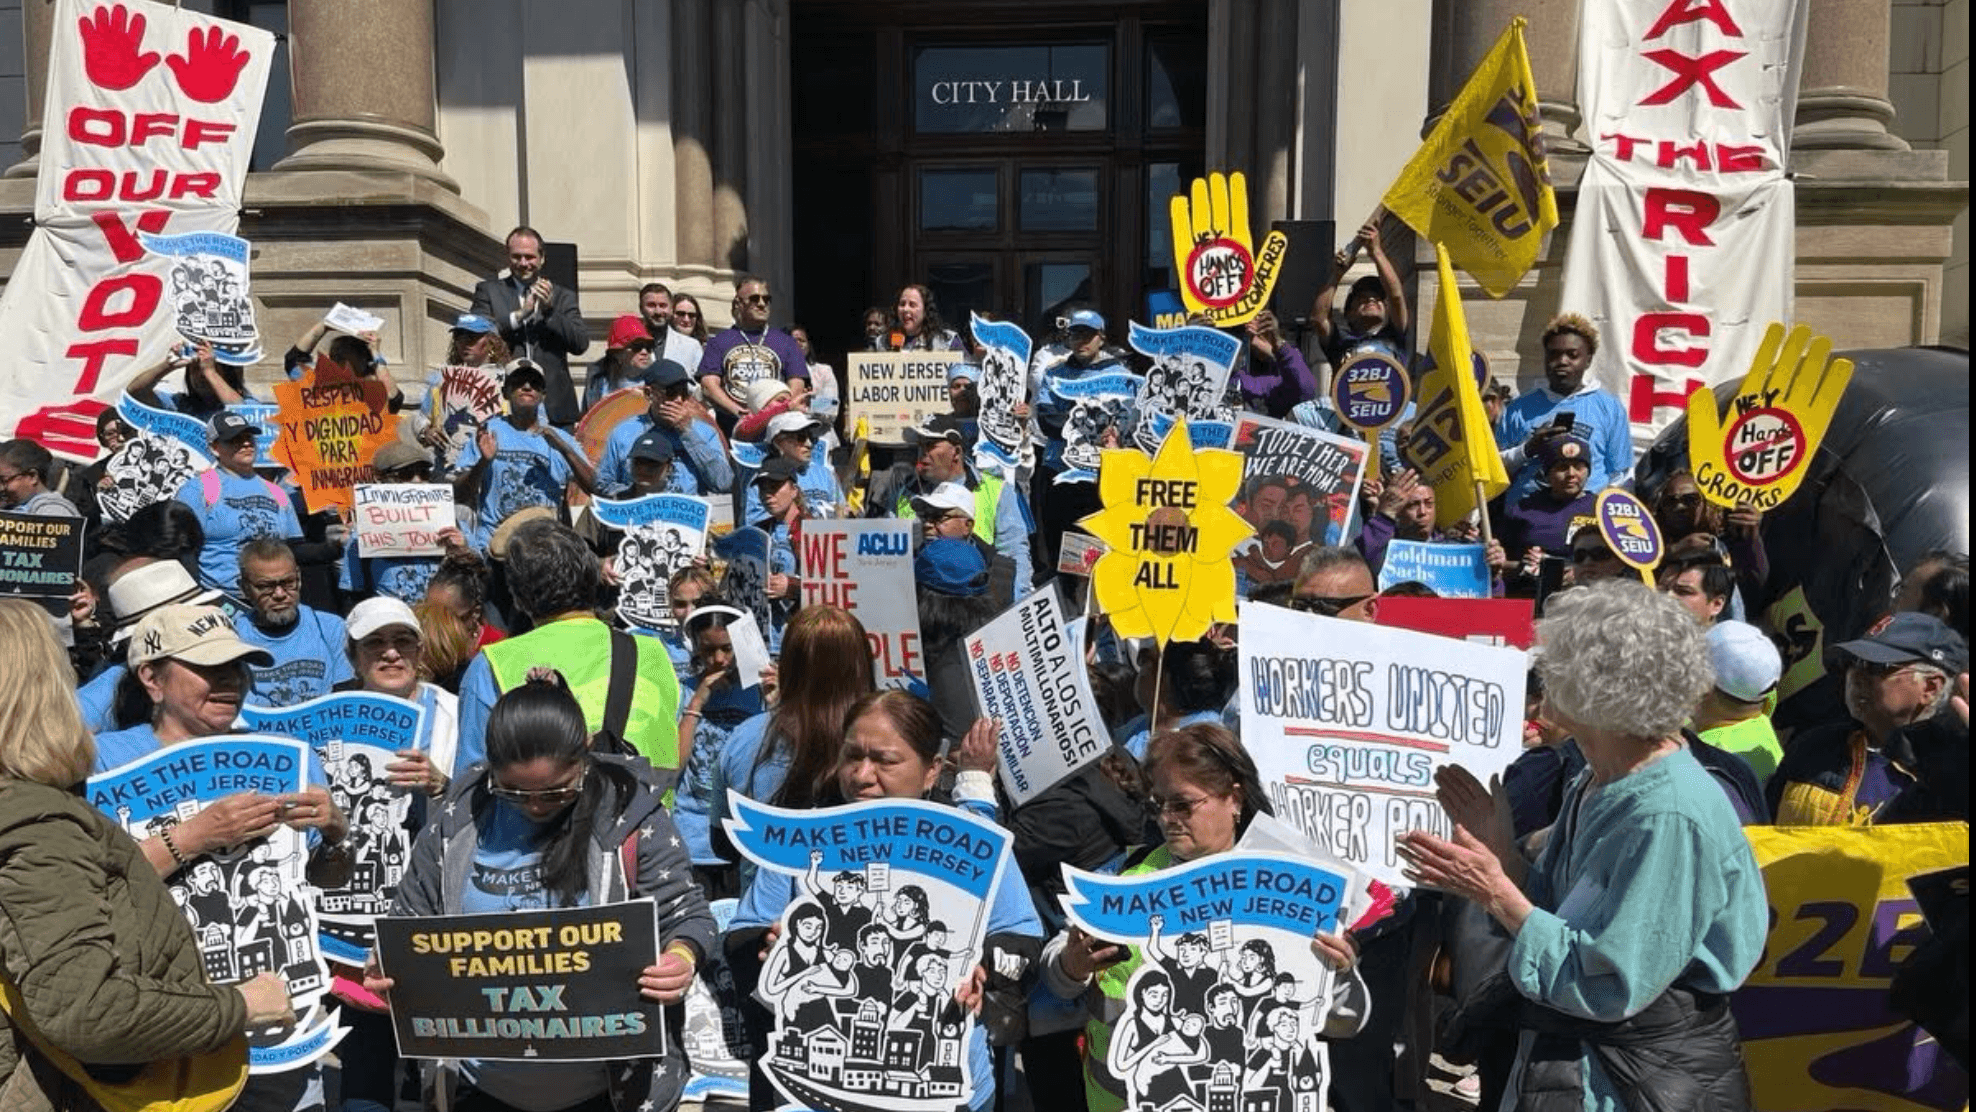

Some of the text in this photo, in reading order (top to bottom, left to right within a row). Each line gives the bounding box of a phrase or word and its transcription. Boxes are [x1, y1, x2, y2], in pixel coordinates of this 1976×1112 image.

[932, 80, 1090, 104] CITY HALL
[67, 106, 237, 150] OFF
[1600, 134, 1778, 173] THE
[63, 169, 221, 201] OUR
[1436, 153, 1532, 240] SEIU
[1199, 252, 1247, 277] HANDS
[1629, 187, 1721, 424] RICH
[15, 210, 174, 459] VOTE
[1155, 312, 1186, 329] MA
[1143, 333, 1235, 352] MAKE THE ROAD
[859, 363, 895, 380] NEW
[1347, 366, 1392, 383] 32BJ
[853, 385, 900, 402] LABOR
[1735, 388, 1780, 416] HEY
[130, 407, 162, 426] MAKE
[1350, 403, 1392, 418] SEIU
[285, 421, 299, 442] Y
[304, 412, 384, 442] DIGNIDAD
[1201, 427, 1224, 438] THE
[320, 440, 359, 463] PARA
[1256, 428, 1350, 476] TOGETHER
[1738, 445, 1795, 475] OFF
[1245, 455, 1341, 493] WE ARE HOME
[1697, 462, 1782, 507] CROOKS
[1135, 479, 1198, 508] FREE
[366, 505, 438, 525] BUILT
[608, 500, 705, 517] MAKE THE ROAD
[1606, 503, 1641, 517] 32BJ
[45, 523, 71, 536] OUR
[358, 532, 397, 548] THIS
[858, 533, 909, 555] ACLU
[1130, 523, 1198, 553] THEM
[2, 551, 44, 568] TAX
[803, 533, 849, 579] WE
[1621, 540, 1654, 553] SEIU
[1134, 561, 1180, 590] ALL
[803, 583, 858, 610] THE
[187, 614, 218, 637] NEW
[1018, 605, 1079, 767] MULTIMILLONARIOS!
[1034, 597, 1097, 758] ALTO A LOS ICE
[989, 651, 1032, 759] NO DEPORTACIÓN
[1005, 650, 1043, 742] NO DETENCIÓN
[1251, 656, 1505, 748] WORKERS UNITED
[257, 704, 413, 732] MAKE THE ROAD
[970, 639, 1028, 793] NO SEPARACI FAMILIAR
[308, 724, 408, 745] NEW JERSEY
[151, 754, 207, 783] THE
[213, 750, 293, 773] ROAD
[1307, 744, 1432, 787] equals
[145, 773, 292, 812] NEW JERSEY
[764, 816, 994, 861] MAKE THE ROAD
[840, 843, 985, 883] NEW JERSEY
[482, 871, 531, 886] MAKE
[1102, 869, 1337, 917] MAKE THE ROAD
[1180, 896, 1330, 929] NEW JERSEY
[412, 921, 623, 955] SUPPORT OUR
[1751, 900, 1927, 978] 2B
[450, 951, 591, 978] FAMILIES
[481, 985, 567, 1013] TAX
[411, 1012, 646, 1039] BILLIONAIRES
